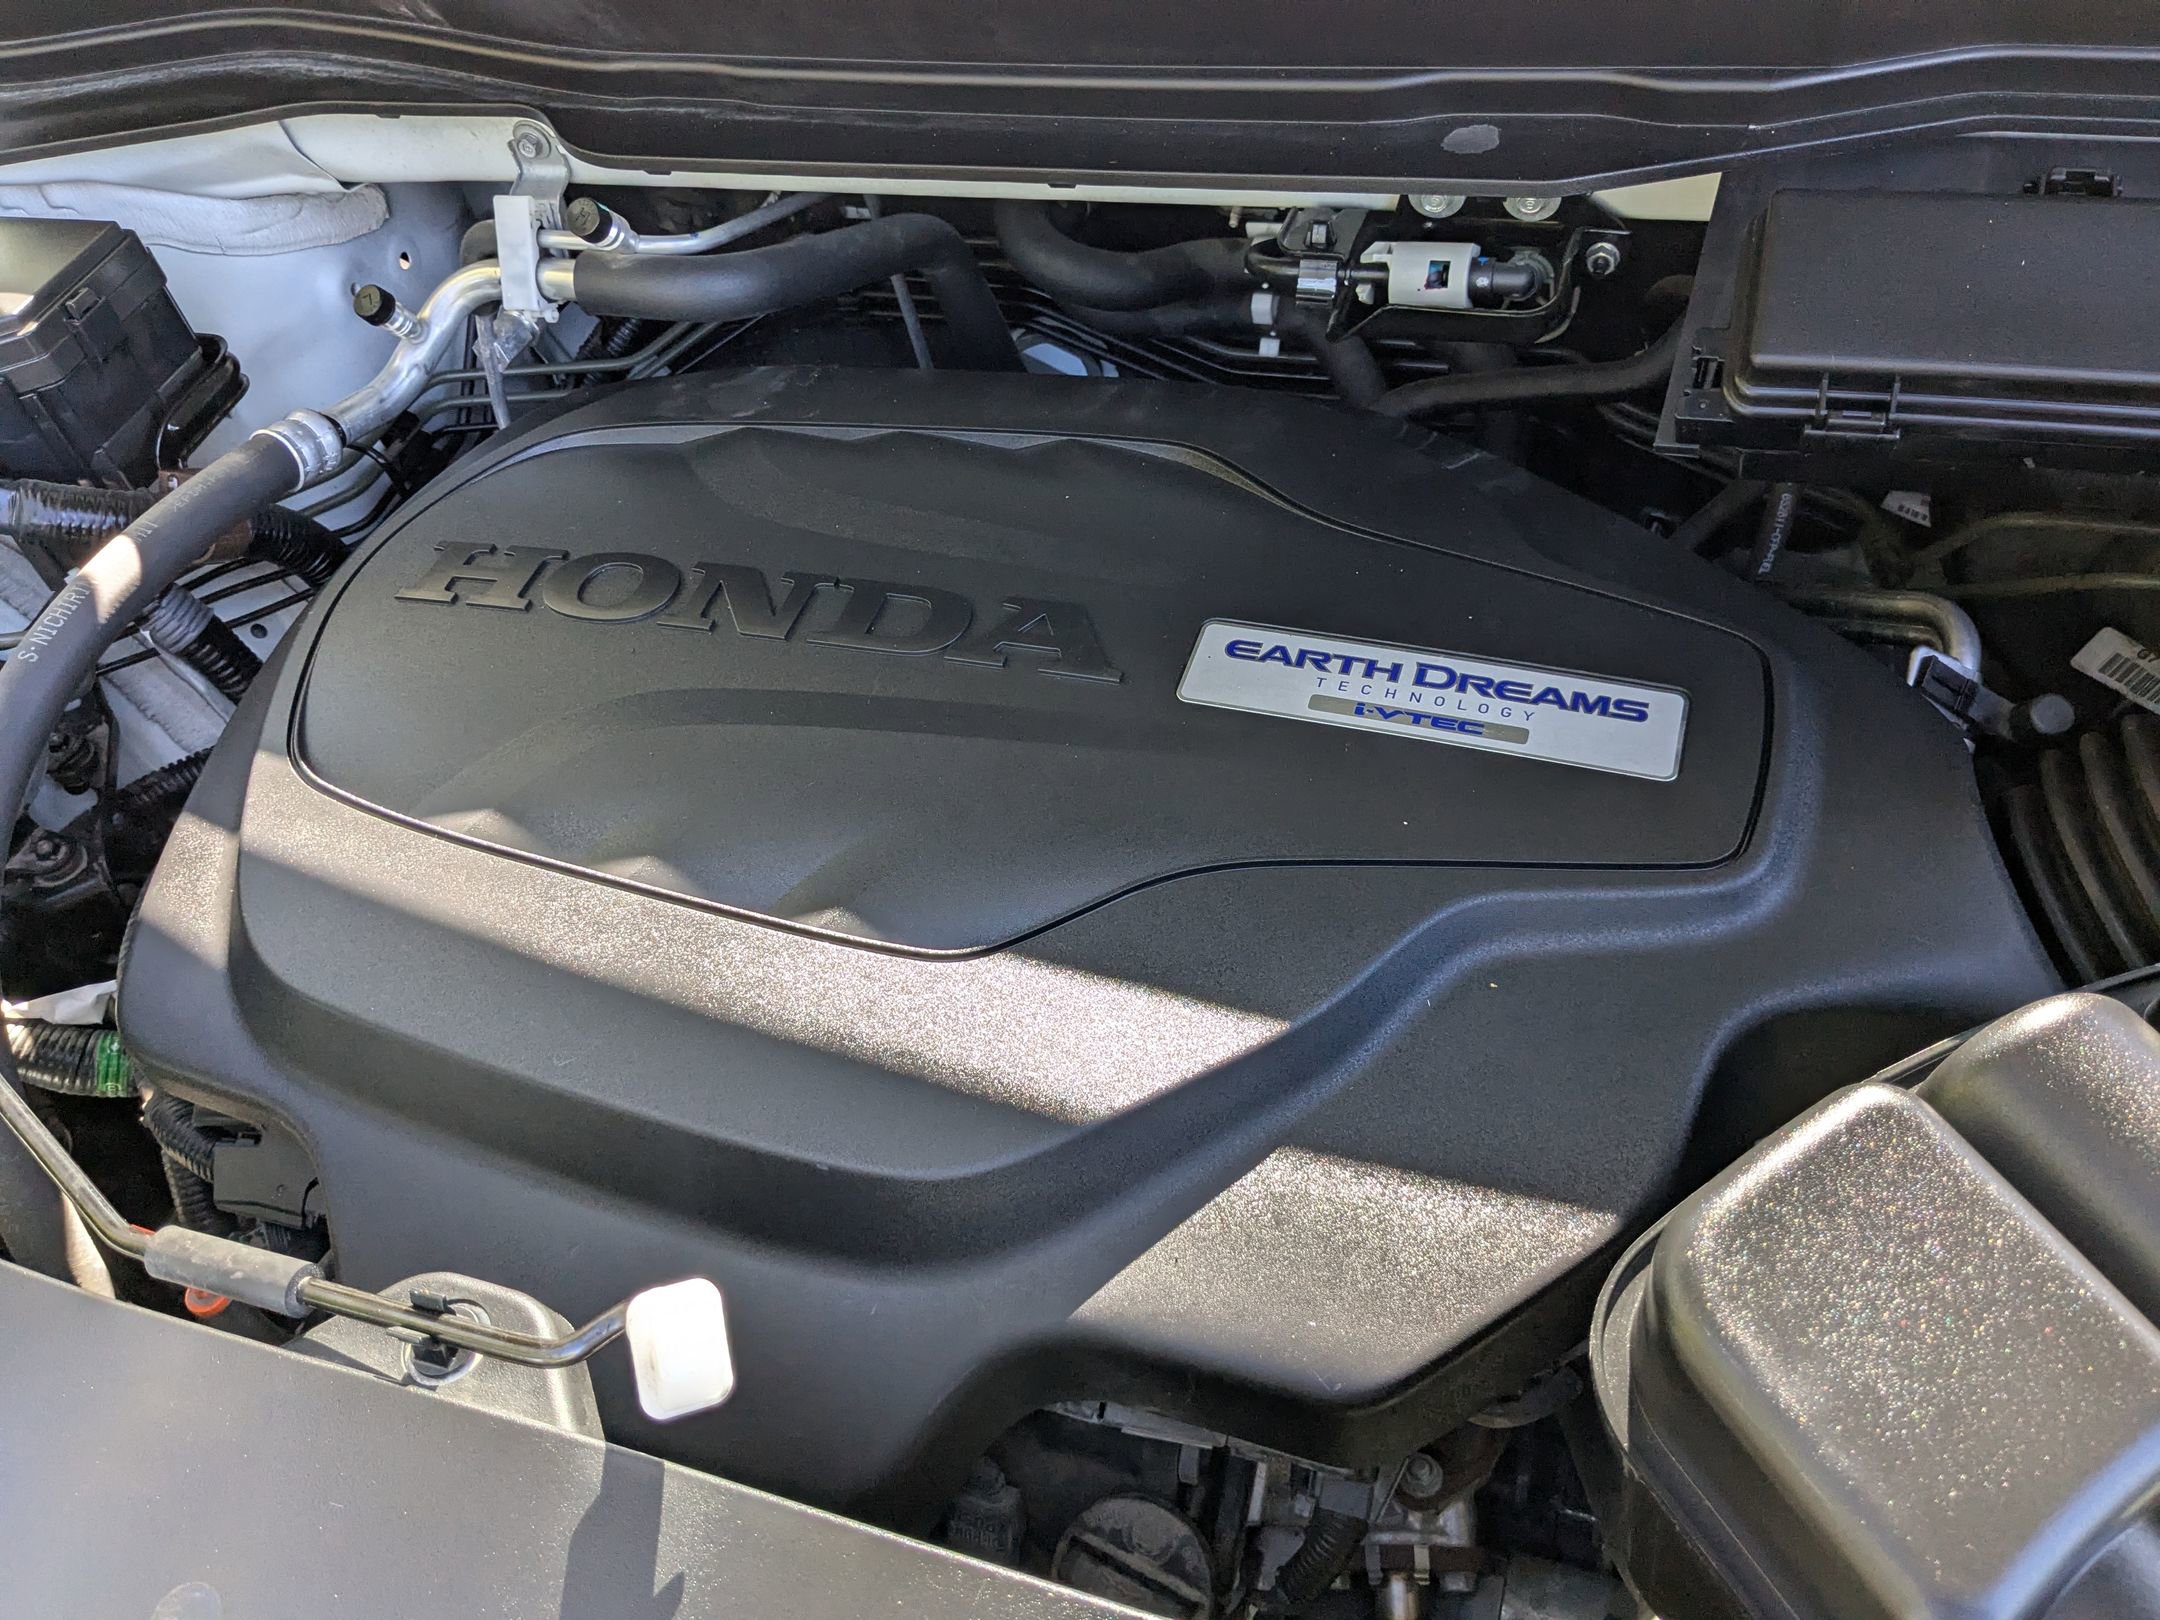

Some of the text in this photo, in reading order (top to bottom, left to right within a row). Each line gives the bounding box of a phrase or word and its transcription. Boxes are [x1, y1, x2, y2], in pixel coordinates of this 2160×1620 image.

[394, 540, 1124, 683] HONDA
[1224, 639, 1650, 723] EARTH DREAMS
[1316, 677, 1537, 722] TECHNOLOGY
[1353, 702, 1487, 736] i-VTEC
